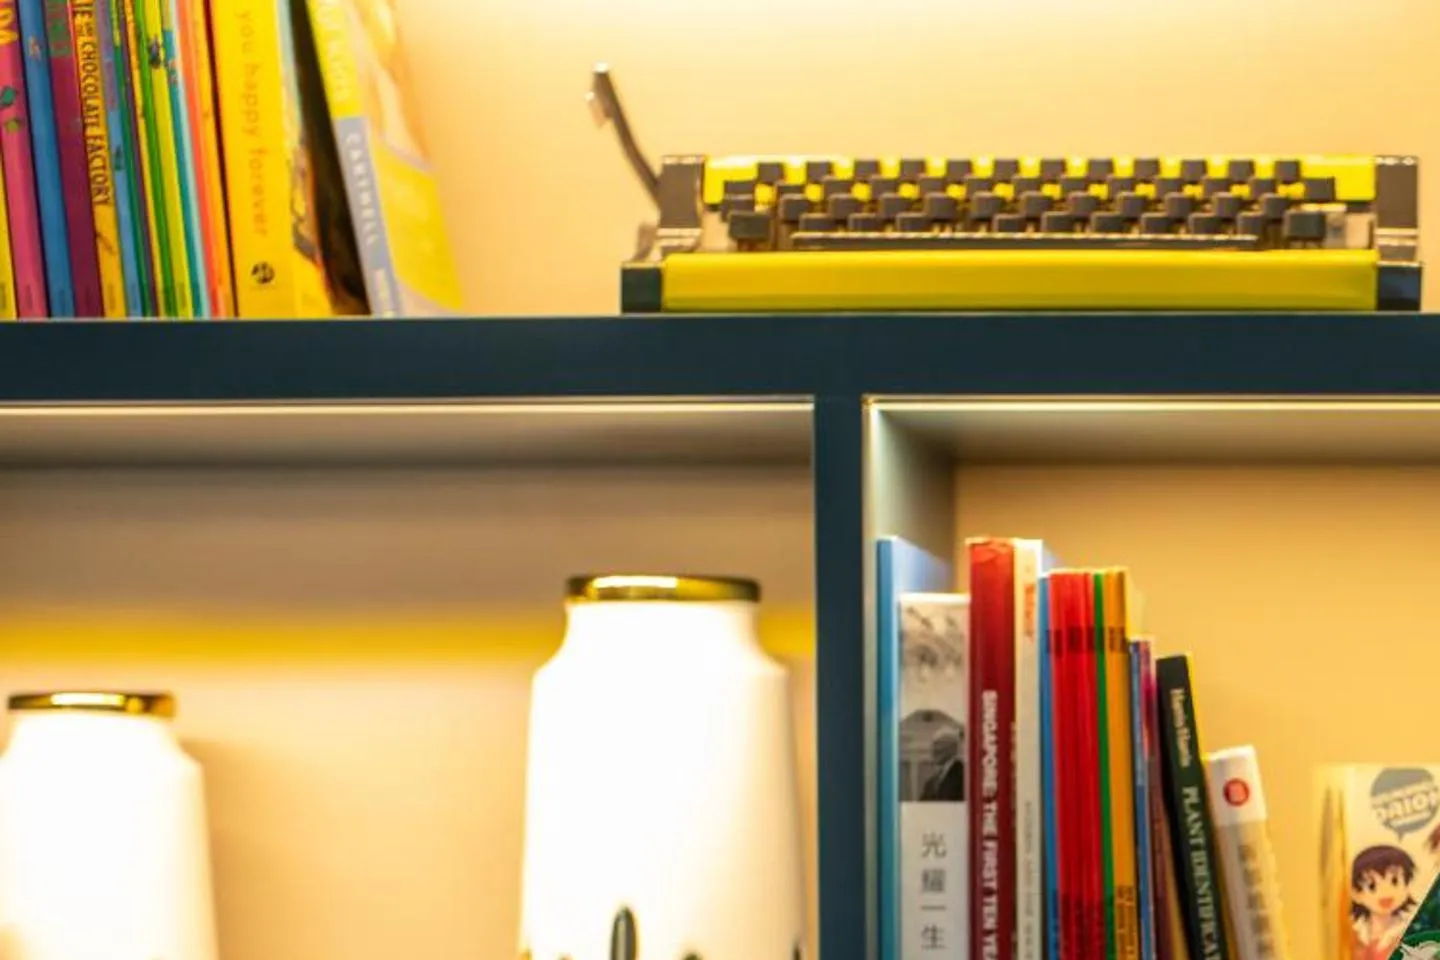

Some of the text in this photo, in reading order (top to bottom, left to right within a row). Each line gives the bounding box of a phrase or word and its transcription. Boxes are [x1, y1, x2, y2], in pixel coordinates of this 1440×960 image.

[81, 41, 101, 129] CHOCOLATE
[234, 11, 269, 238] you happy forever
[86, 134, 111, 206] FACTORY
[981, 690, 999, 796] SINGAPORE:
[981, 801, 999, 835] THE
[1182, 785, 1205, 845] PLANT
[981, 840, 999, 890] FIRST
[981, 895, 999, 929] TEN
